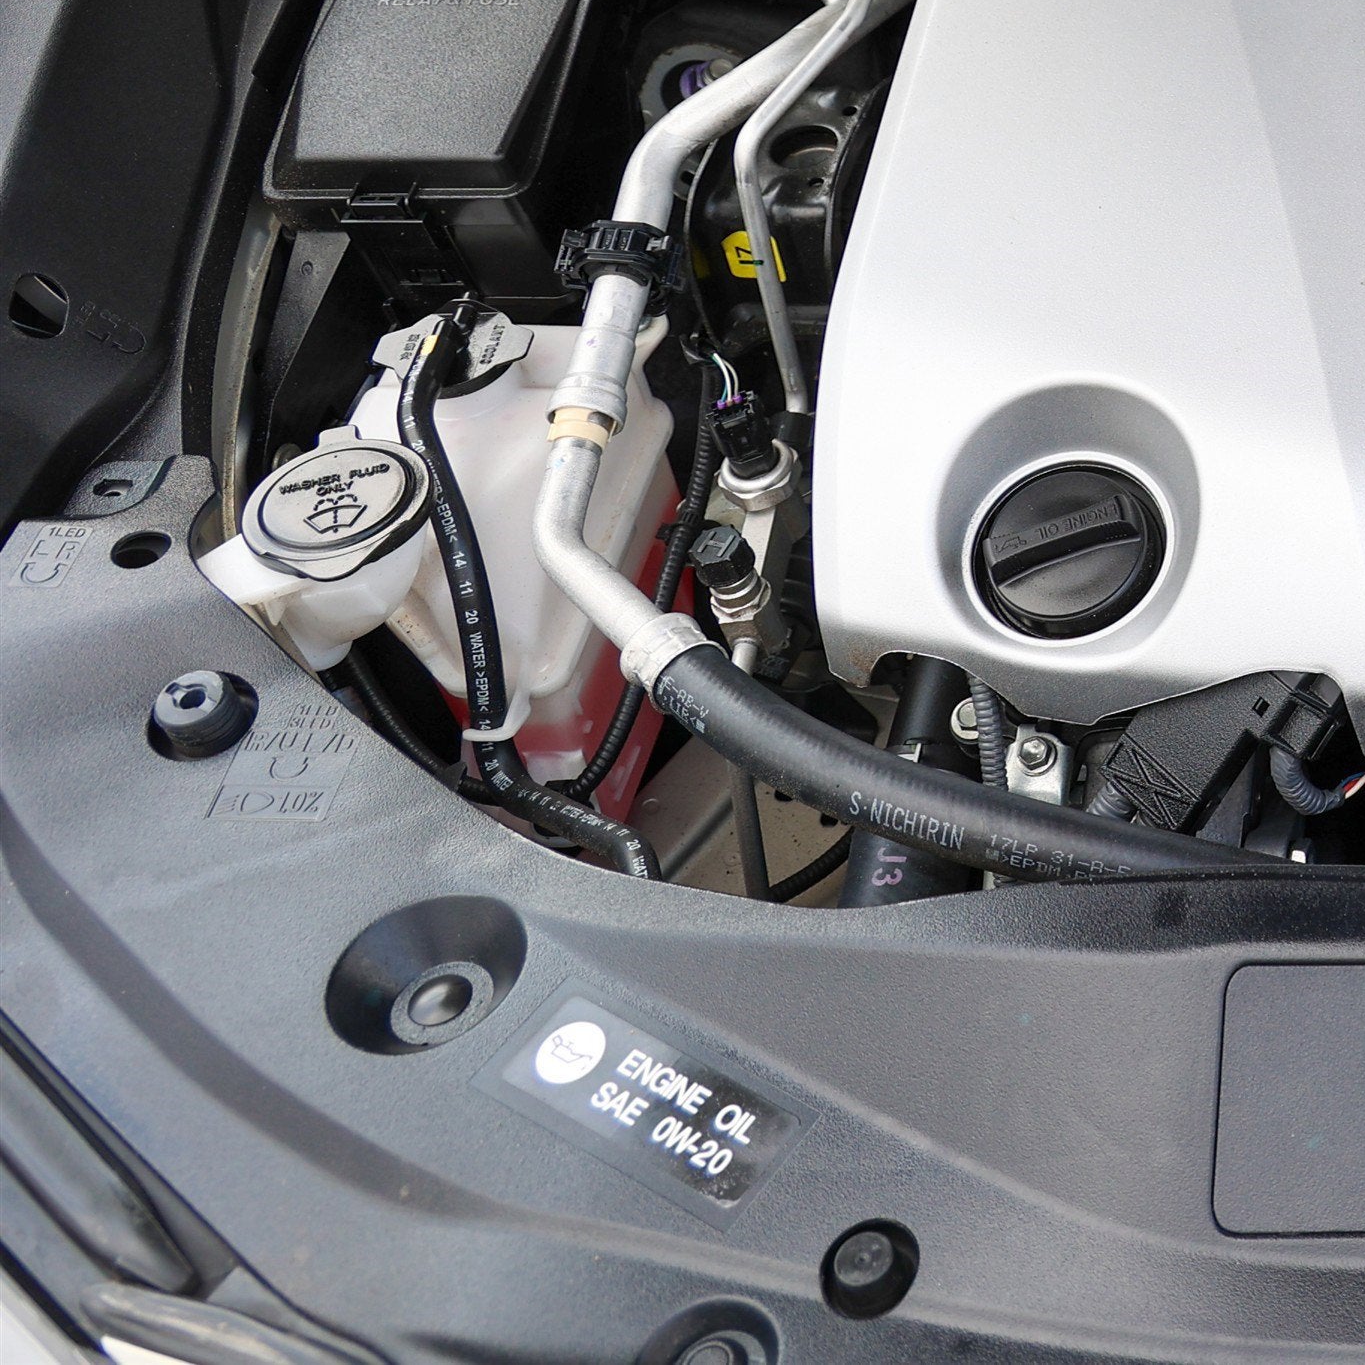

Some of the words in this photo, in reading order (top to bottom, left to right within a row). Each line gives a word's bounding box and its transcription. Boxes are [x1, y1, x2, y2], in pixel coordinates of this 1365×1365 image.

[480, 323, 506, 366] COOLANT
[410, 439, 425, 454] 20
[279, 473, 342, 496] WASHER
[350, 462, 390, 480] FLUID
[316, 480, 354, 498] ONLY
[49, 526, 87, 538] 1LED
[1036, 523, 1059, 540] OIL
[450, 551, 467, 570] 14
[458, 581, 473, 595] 11
[465, 609, 479, 625] 20
[469, 631, 487, 668] WATER
[484, 759, 498, 771] 20
[625, 838, 640, 851] 20
[616, 1048, 713, 1115] ENGINE
[714, 1104, 756, 1145] OIL
[590, 1082, 650, 1127] SAE
[651, 1116, 733, 1175] 0W-20
